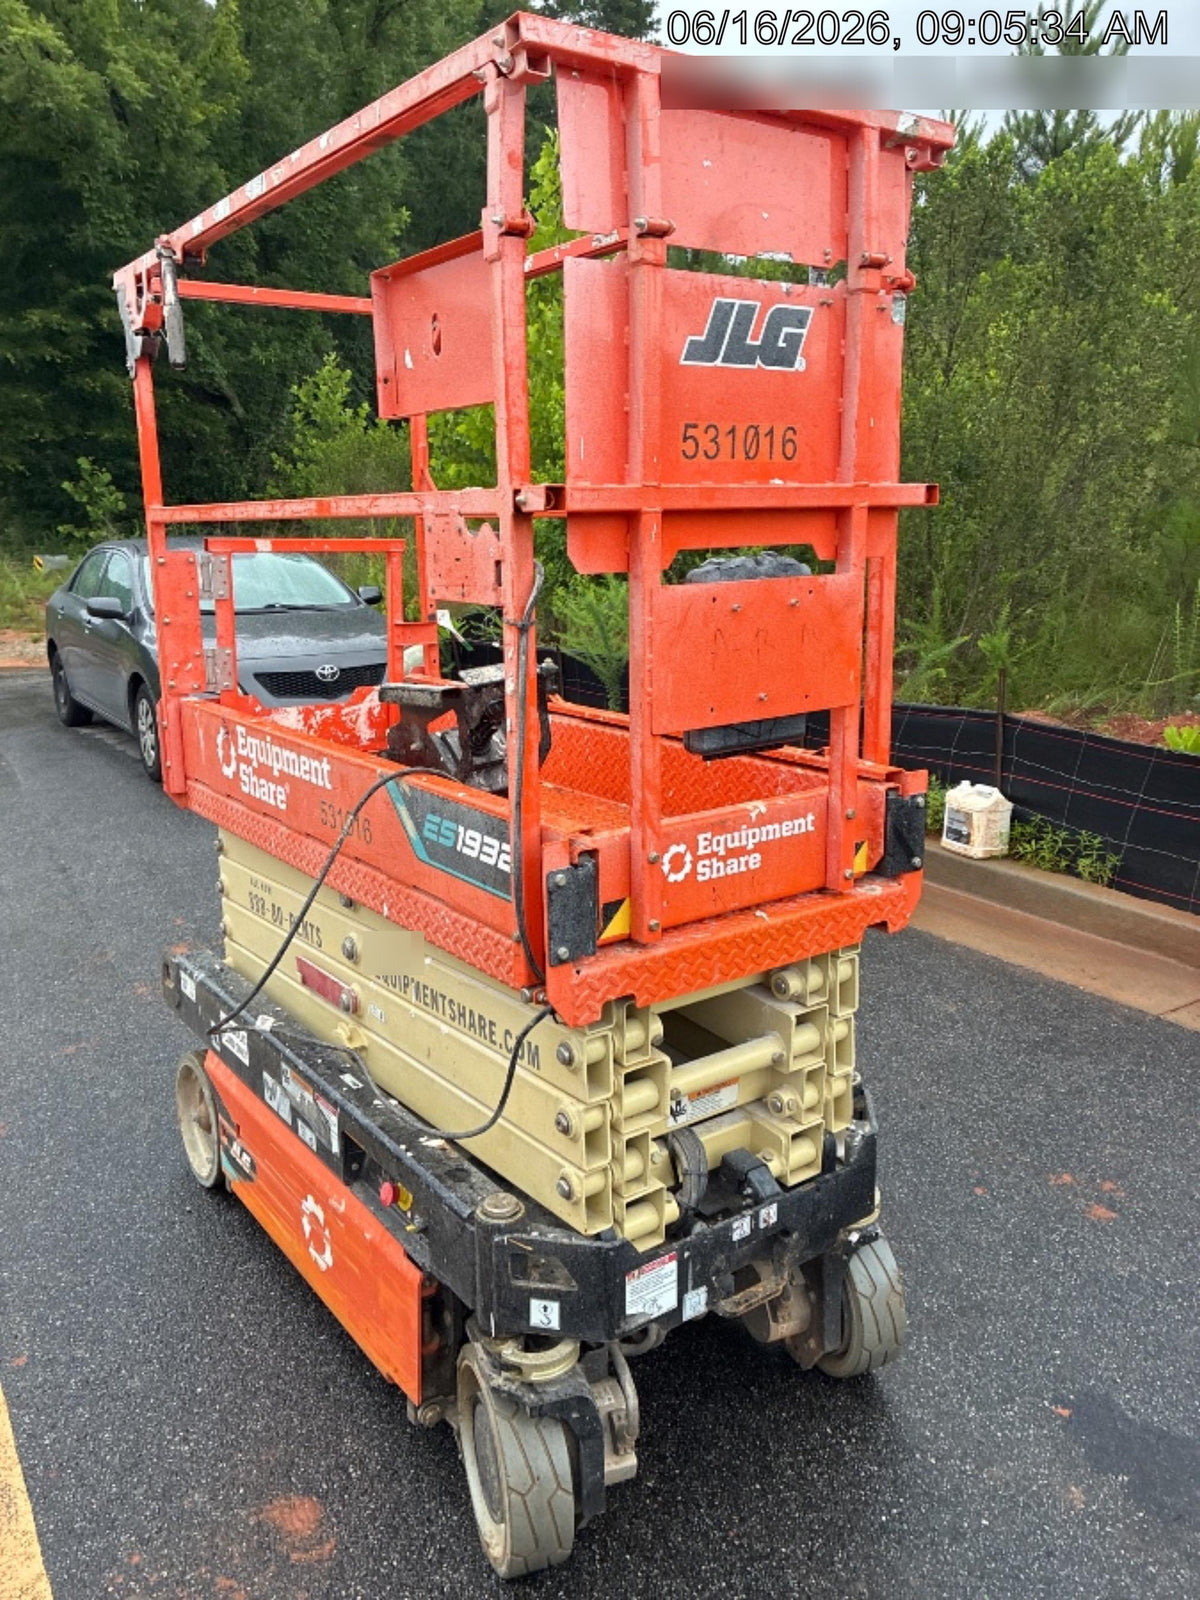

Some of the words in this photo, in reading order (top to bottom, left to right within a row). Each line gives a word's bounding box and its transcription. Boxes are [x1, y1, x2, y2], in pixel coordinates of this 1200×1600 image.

[679, 297, 815, 371] JLG
[682, 422, 798, 461] 531016
[235, 724, 333, 790] Equipment
[239, 762, 288, 811] Share
[422, 812, 512, 874] ES1932
[696, 811, 816, 856] Equipment
[696, 852, 762, 882] Share
